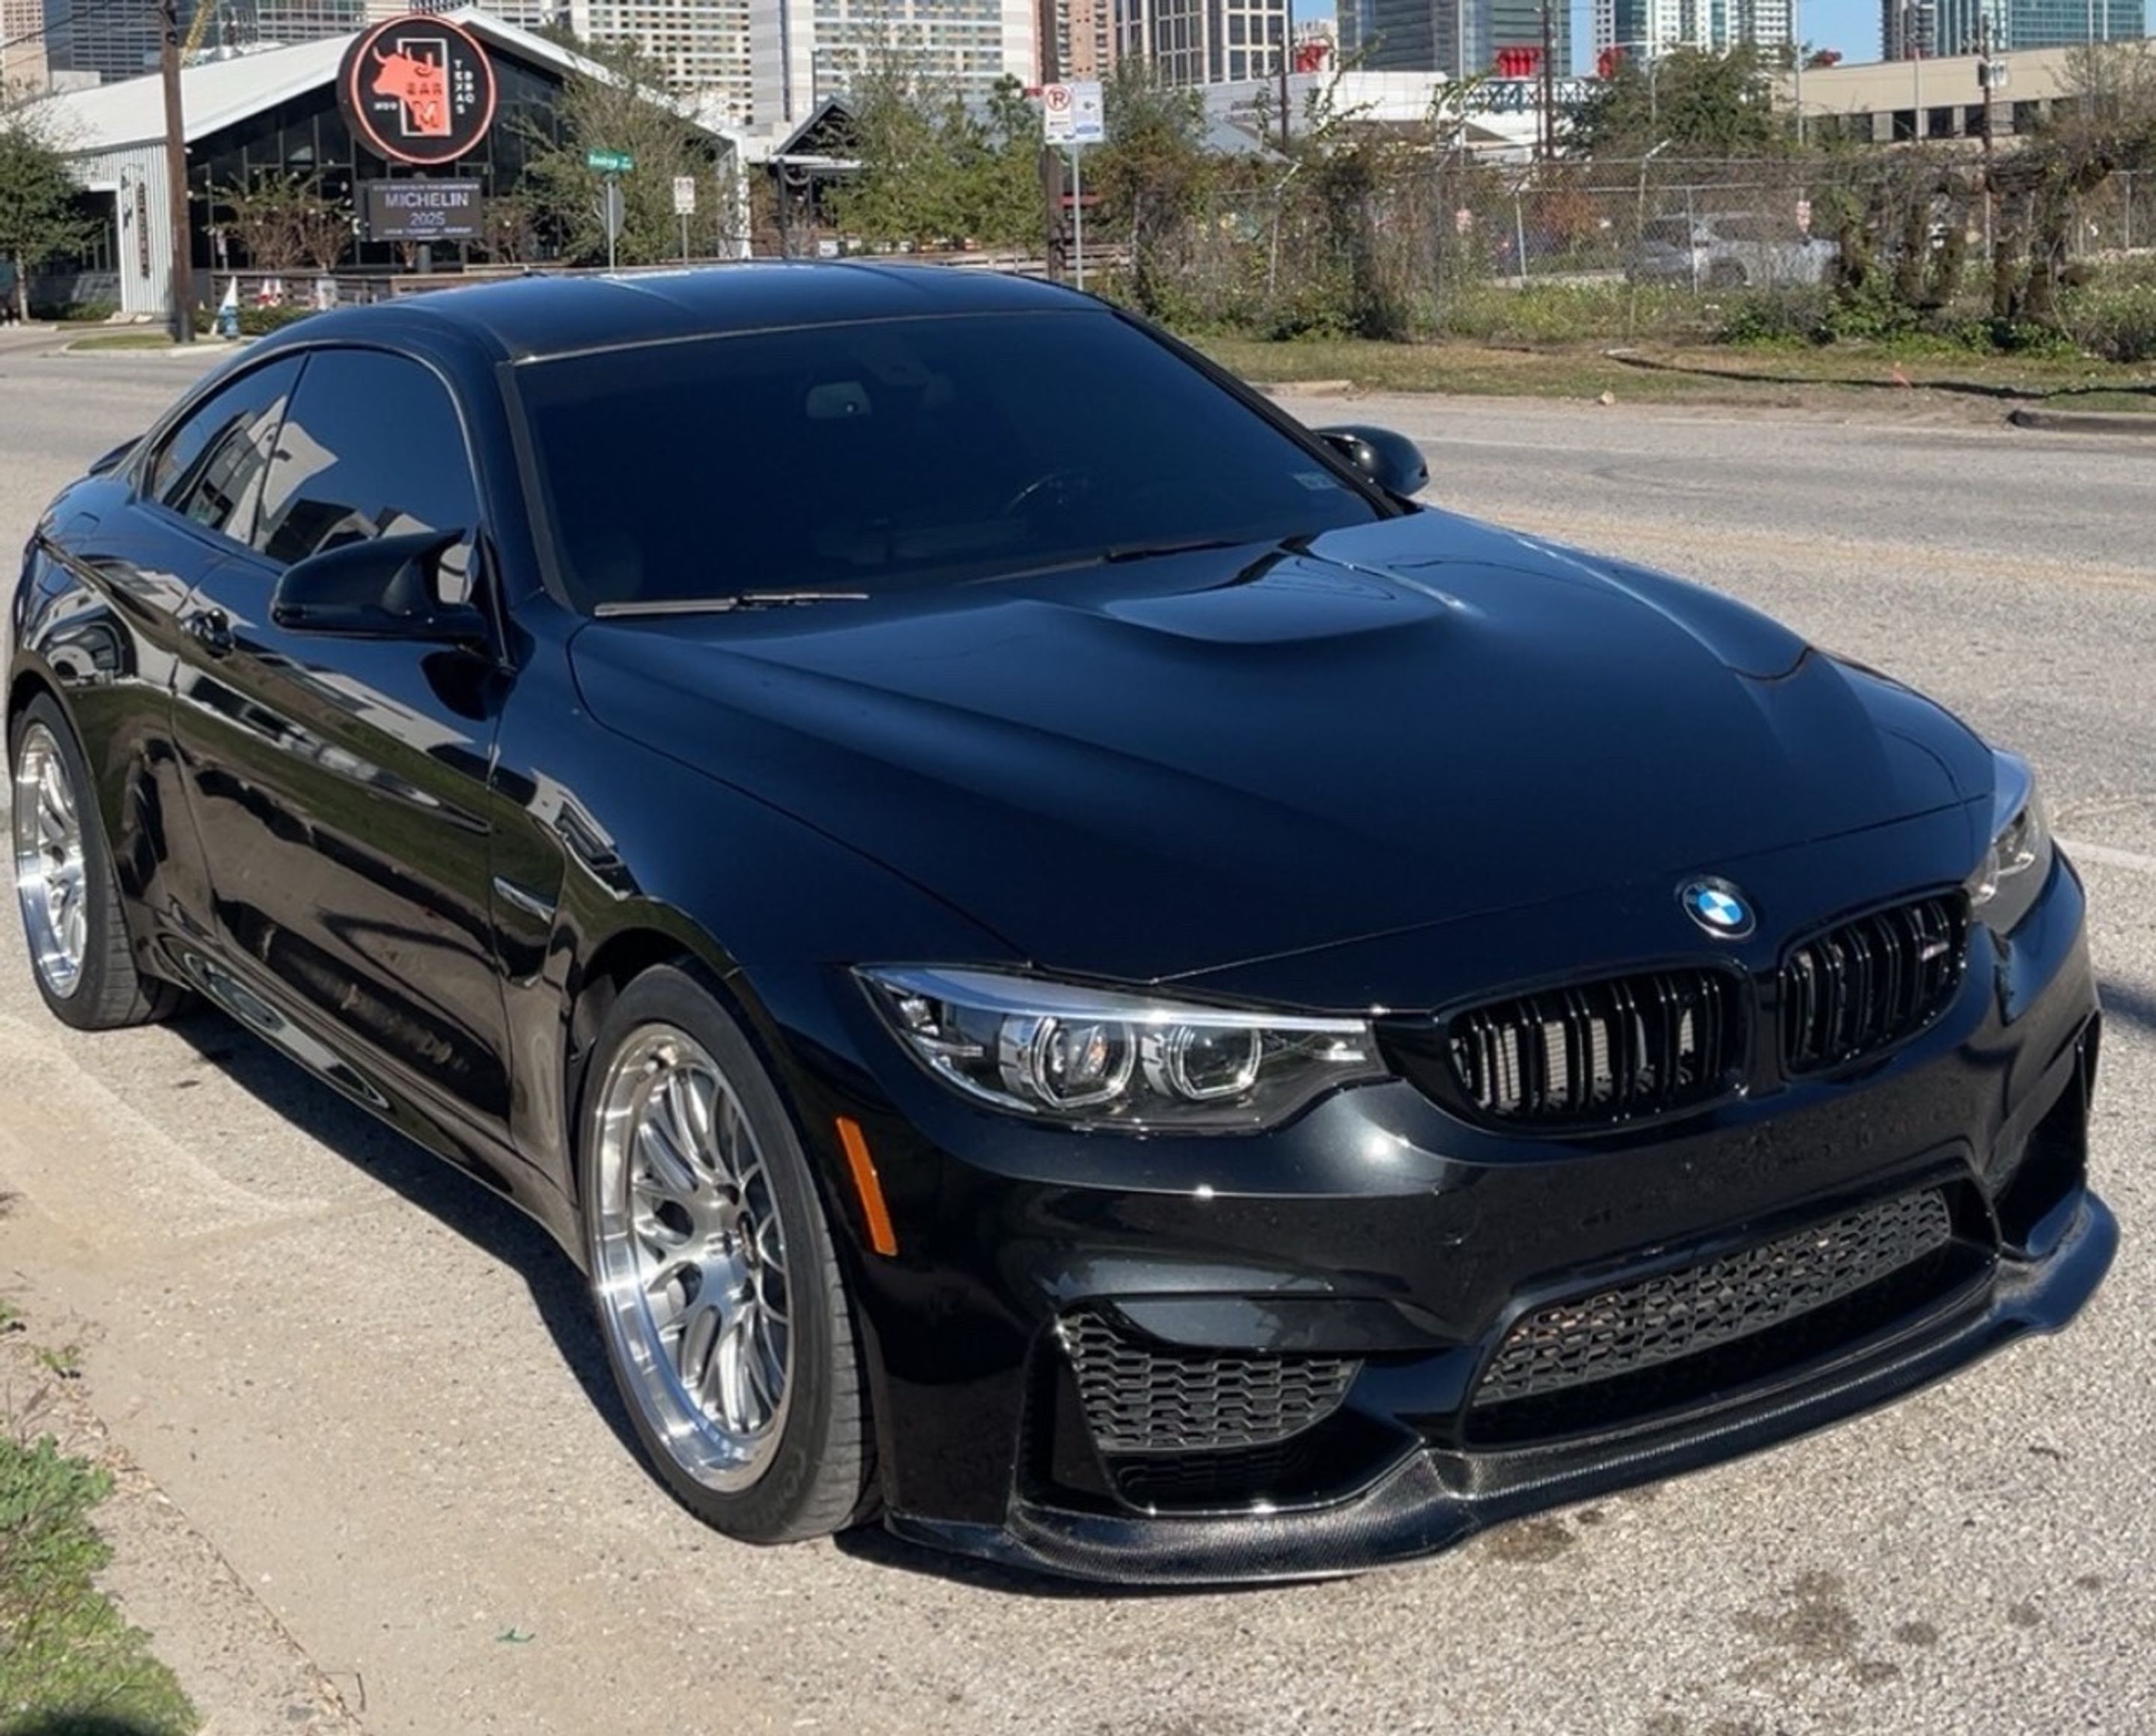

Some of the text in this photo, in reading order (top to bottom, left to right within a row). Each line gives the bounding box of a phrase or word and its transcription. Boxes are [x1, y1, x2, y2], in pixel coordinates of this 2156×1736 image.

[406, 82, 442, 95] BAR
[454, 58, 466, 115] TEXAS
[464, 70, 476, 104] BBQ
[385, 192, 469, 208] MICHELIN
[409, 211, 446, 226] 2025
